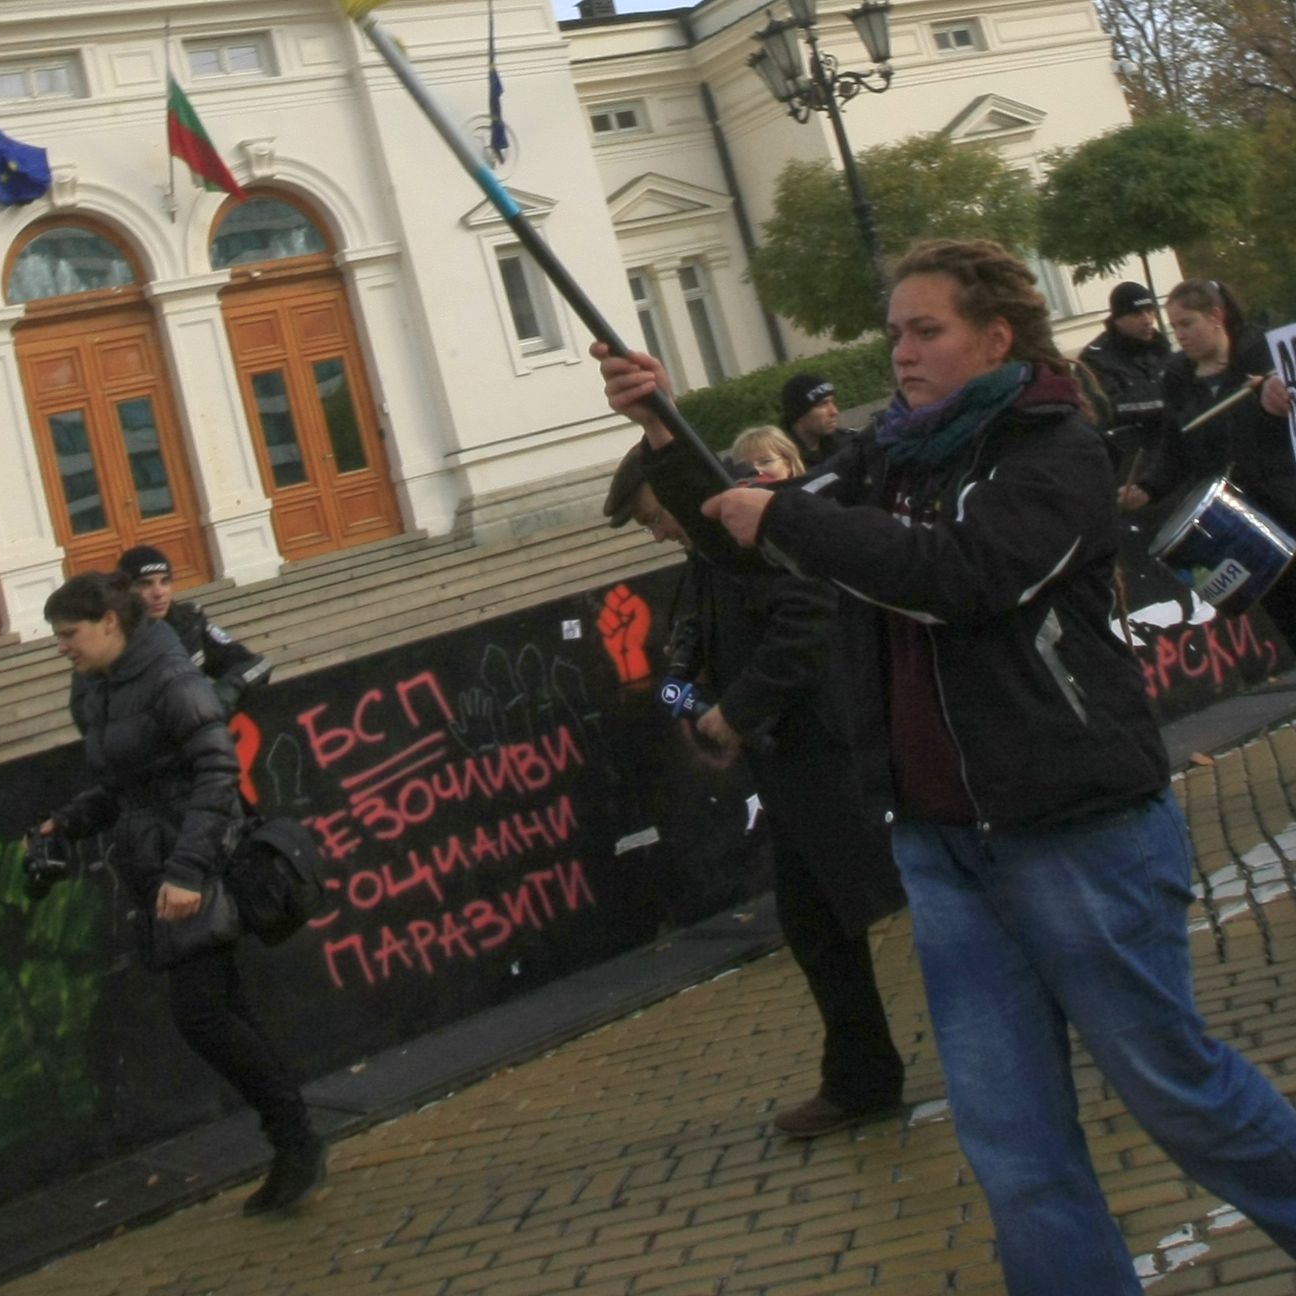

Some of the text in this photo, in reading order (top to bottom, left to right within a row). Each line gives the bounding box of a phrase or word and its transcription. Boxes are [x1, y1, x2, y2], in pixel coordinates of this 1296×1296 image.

[1203, 563, 1242, 599] ЦИЯ
[297, 671, 454, 768] БСП
[323, 860, 596, 989] ПАРАЗИТИ
